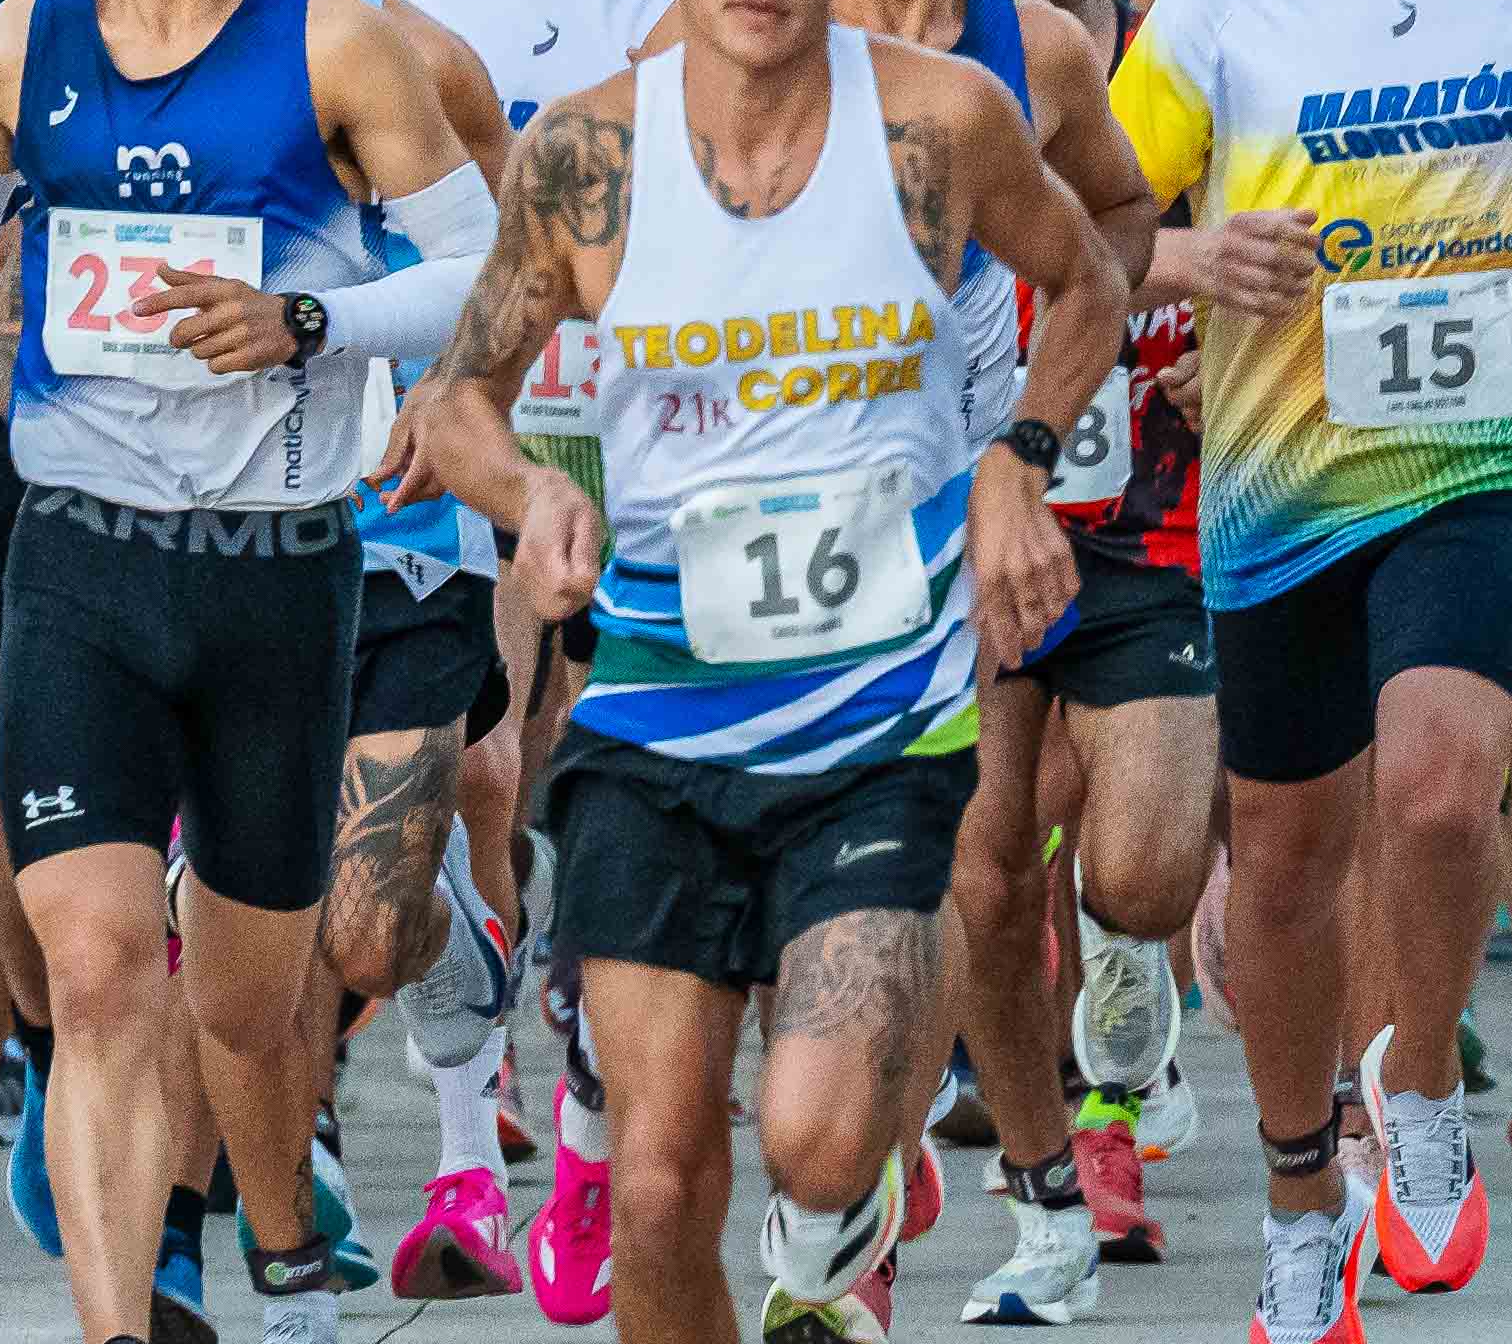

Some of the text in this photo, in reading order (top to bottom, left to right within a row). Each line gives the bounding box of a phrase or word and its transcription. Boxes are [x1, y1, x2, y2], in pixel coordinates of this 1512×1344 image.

[68, 254, 216, 335] 23
[616, 298, 936, 372] TEODELINA
[1377, 318, 1478, 397] 15
[736, 354, 924, 413] CORRE
[744, 526, 861, 619] 16
